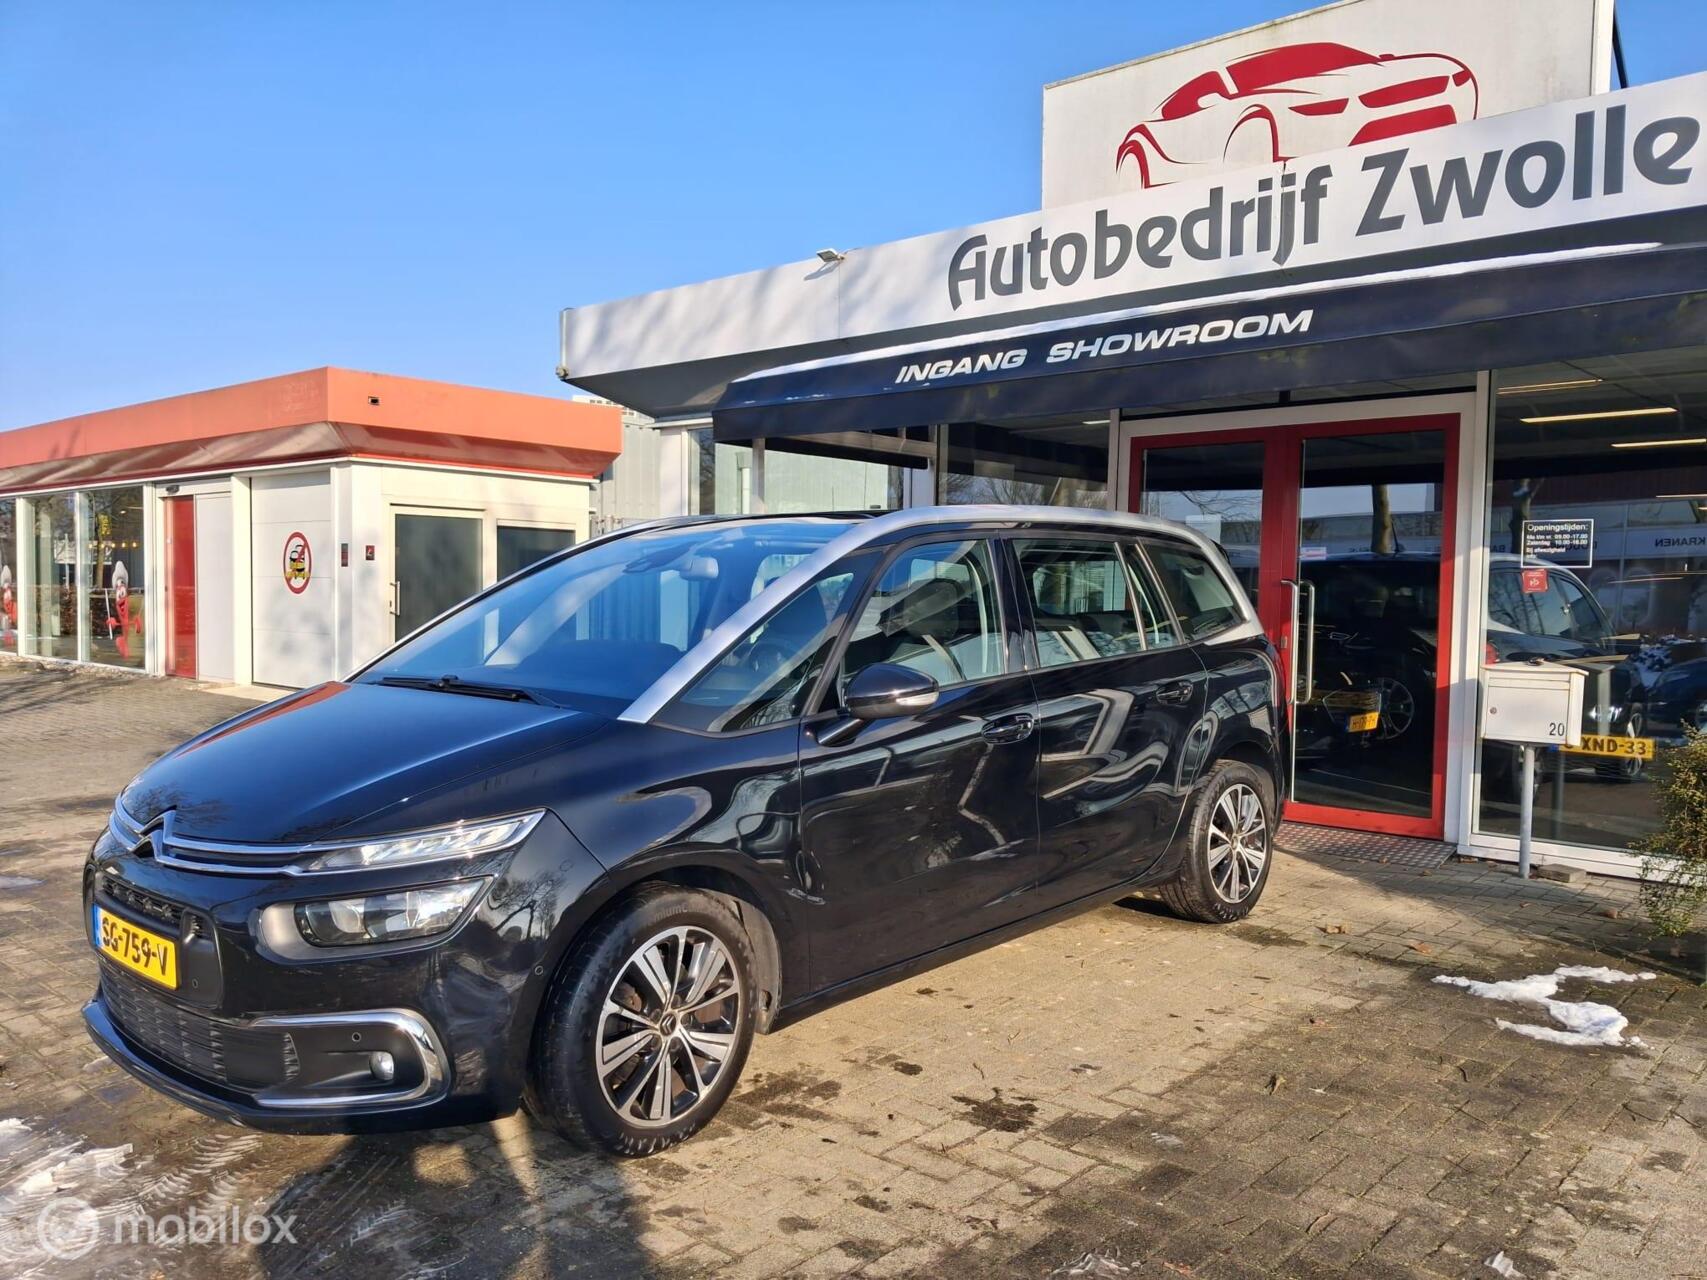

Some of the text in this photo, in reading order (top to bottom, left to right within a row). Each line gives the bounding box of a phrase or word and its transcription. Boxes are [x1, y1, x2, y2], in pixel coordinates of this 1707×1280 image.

[947, 103, 1700, 311] Autobedrijf Zwolle
[894, 309, 1314, 384] INGANG SHOWROOM
[1527, 523, 1589, 533] Openingstijden:
[1549, 722, 1566, 737] 20
[102, 917, 168, 976] SG-759-V
